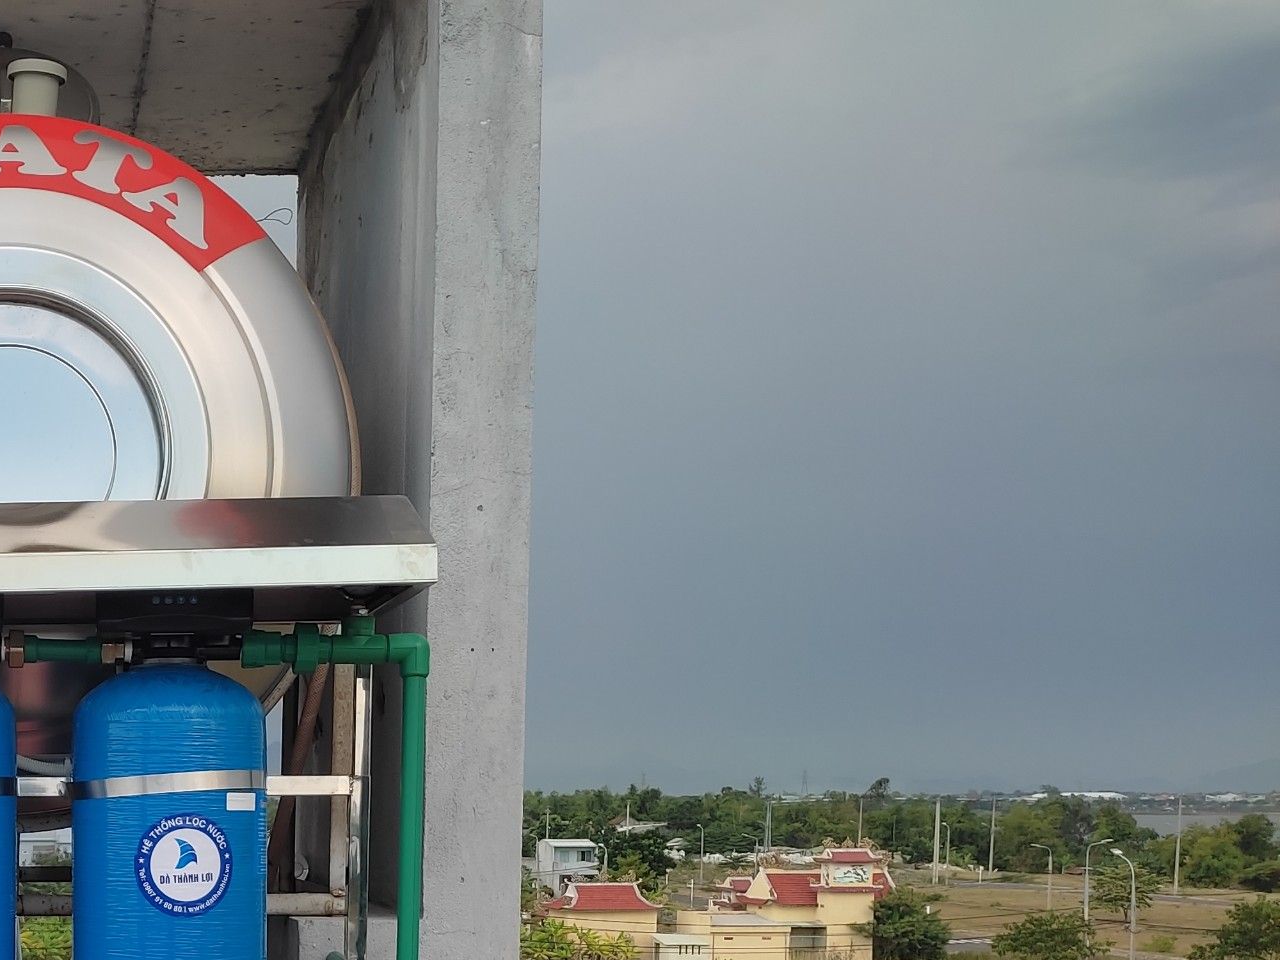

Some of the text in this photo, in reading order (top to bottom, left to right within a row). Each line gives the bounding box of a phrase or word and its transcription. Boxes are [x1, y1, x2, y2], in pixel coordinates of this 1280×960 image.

[141, 816, 227, 854] HỆ THỐNG LỌC NƯỚC
